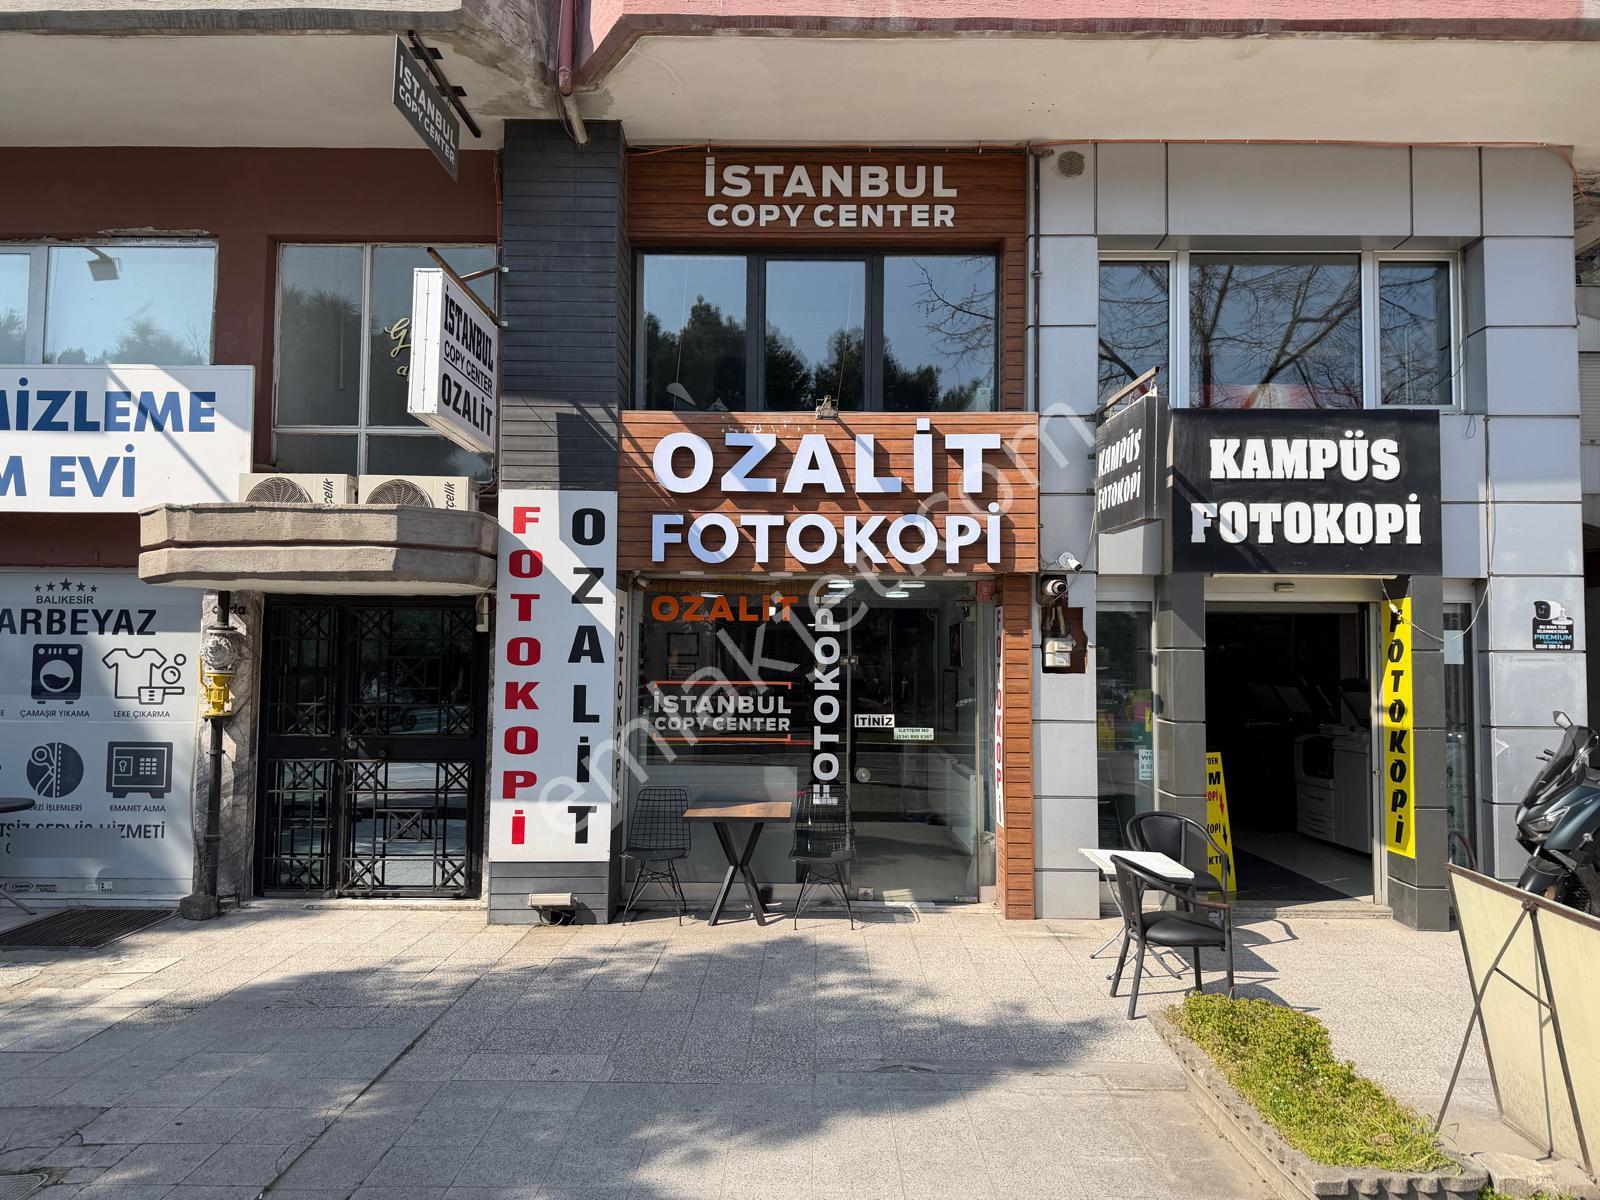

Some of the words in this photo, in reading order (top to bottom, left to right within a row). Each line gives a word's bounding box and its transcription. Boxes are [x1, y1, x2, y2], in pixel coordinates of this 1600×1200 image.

[398, 56, 456, 150] İSTANBUL
[398, 84, 423, 122] COPY
[424, 117, 456, 165] CENTER
[704, 156, 959, 198] İSTANBUL
[707, 203, 804, 228] COPY
[813, 203, 956, 228] CENTER
[443, 284, 495, 373] İSTANBUL
[444, 340, 466, 371] COPY
[466, 357, 494, 395] CENTER
[0, 376, 217, 433] İZLEME
[441, 372, 494, 437] OZALİT
[49, 443, 136, 498] EVİ
[651, 417, 1003, 495] OZALİT
[1097, 427, 1142, 479] KAMPÜS
[1208, 429, 1402, 483] KAMPÜS
[1097, 465, 1142, 513] FOTOKOPİ
[651, 502, 1003, 565] FOTOKOPİ
[1190, 492, 1423, 546] FOTOKOPİ
[36, 593, 94, 605] BALIKESİR
[651, 594, 799, 623] OZALİT
[502, 506, 544, 845] FOTOKOPİ
[567, 507, 607, 845] OZALİT
[653, 690, 793, 715] İSTANBUL
[19, 709, 57, 719] ÇAMAŞIR
[57, 710, 90, 718] YIKAMA
[113, 710, 132, 718] LEKE
[132, 710, 171, 719] ÇIKARMA
[653, 716, 712, 732] COPY
[712, 717, 791, 732] CENTER
[855, 716, 893, 726] İTİNİZ
[1387, 605, 1410, 845] FOTOKOPİ
[46, 803, 82, 812] İŞLEMLERİ
[109, 804, 141, 812] EMANET
[143, 804, 166, 812] ALMA
